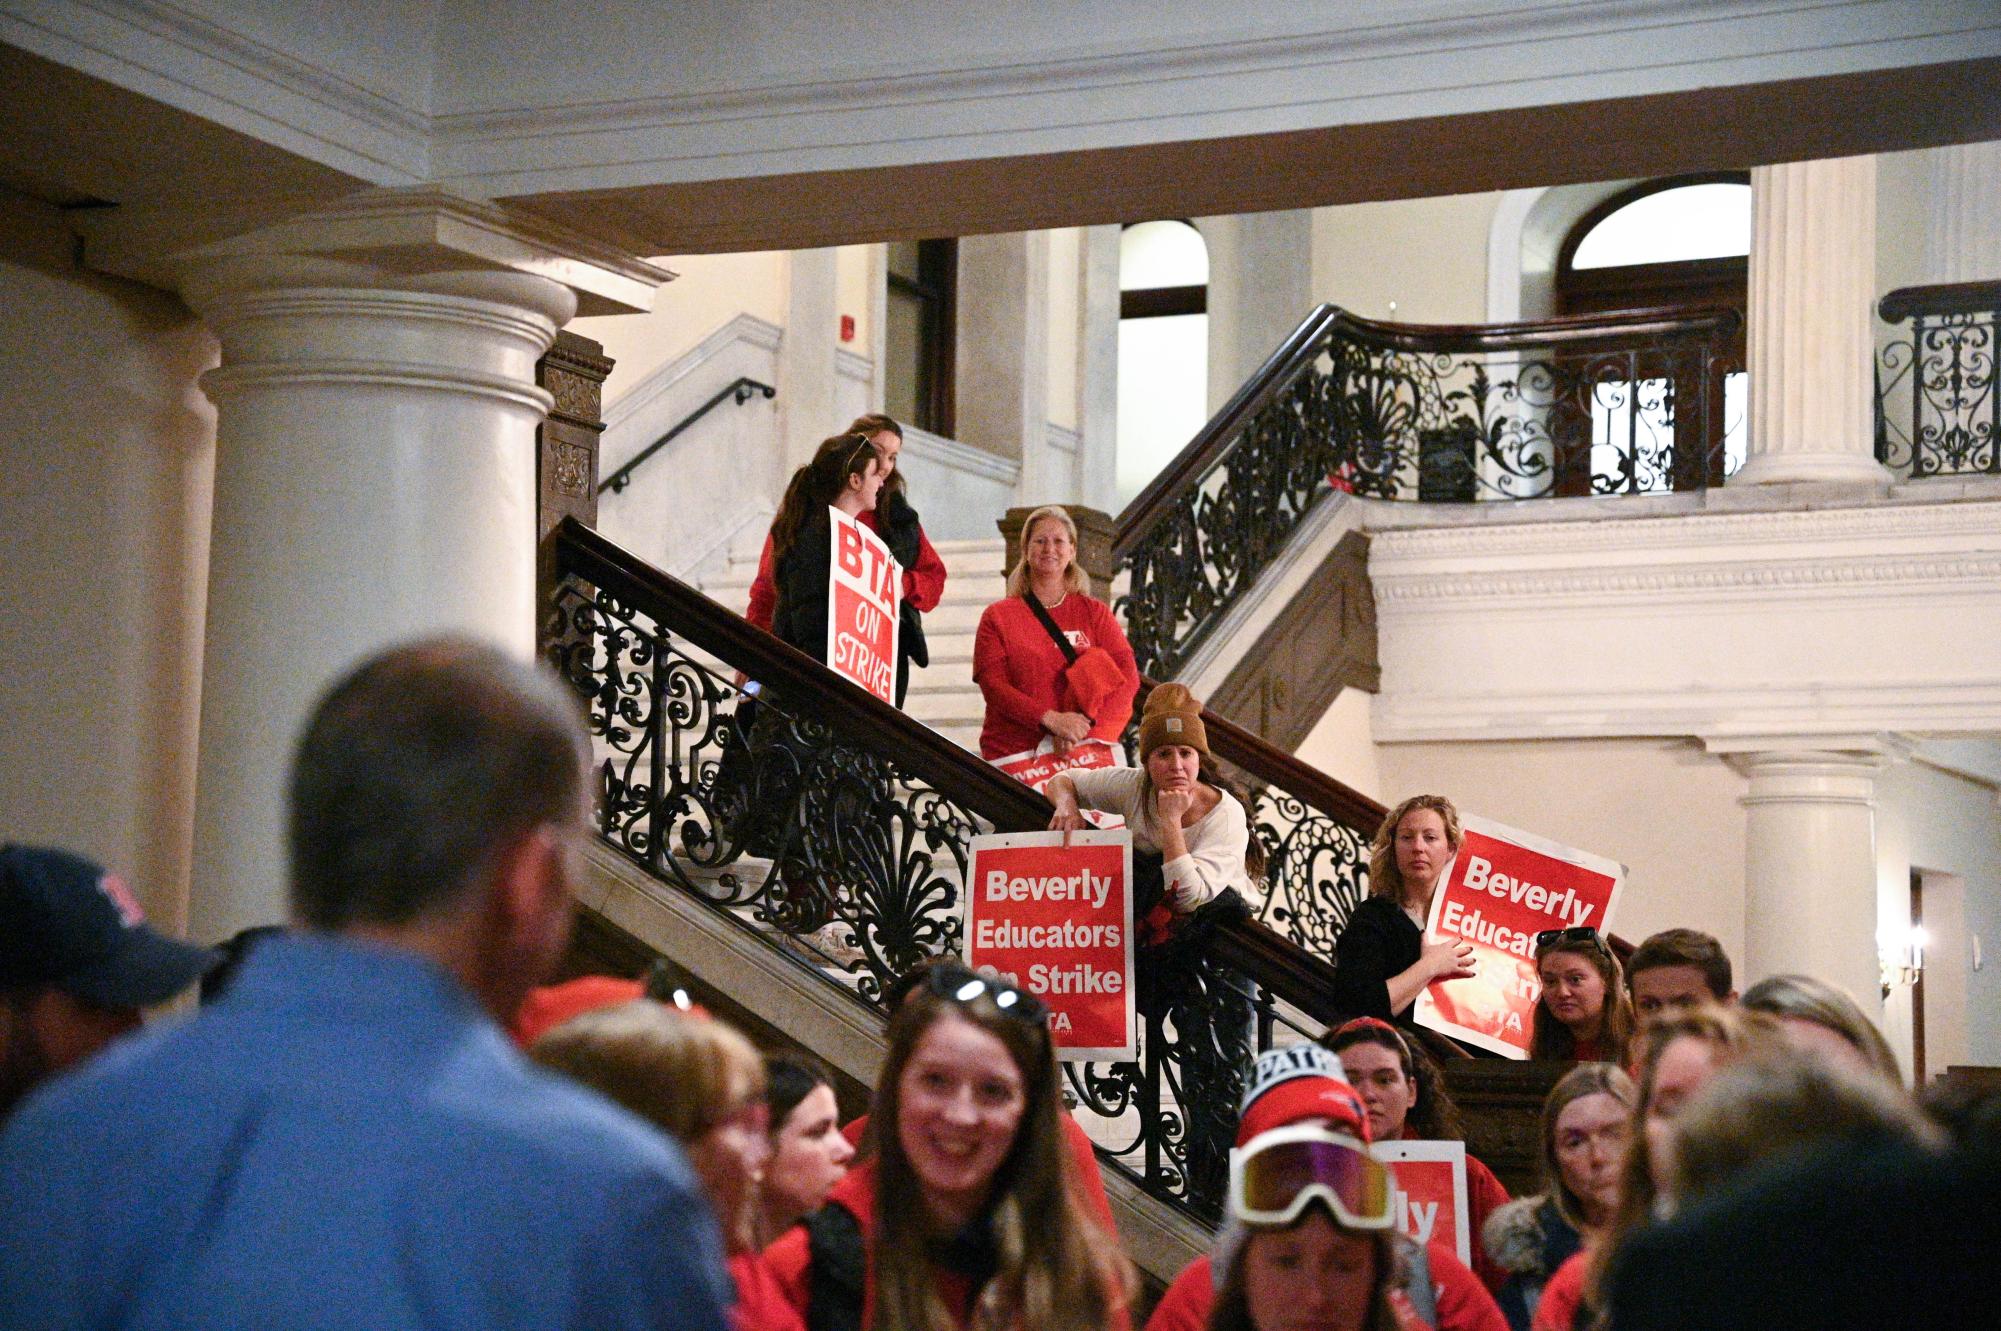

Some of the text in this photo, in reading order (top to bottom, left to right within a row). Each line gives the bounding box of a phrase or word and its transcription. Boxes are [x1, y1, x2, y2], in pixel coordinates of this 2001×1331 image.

[838, 520, 896, 620] BTA
[855, 602, 881, 643] ON
[836, 631, 891, 698] STRIKE
[986, 869, 1112, 908] Beverly
[1463, 855, 1595, 929] Beverly
[976, 918, 1121, 949] Educators
[1441, 900, 1538, 959] Educat
[1028, 964, 1123, 994] Strike
[1046, 1012, 1072, 1030] TA
